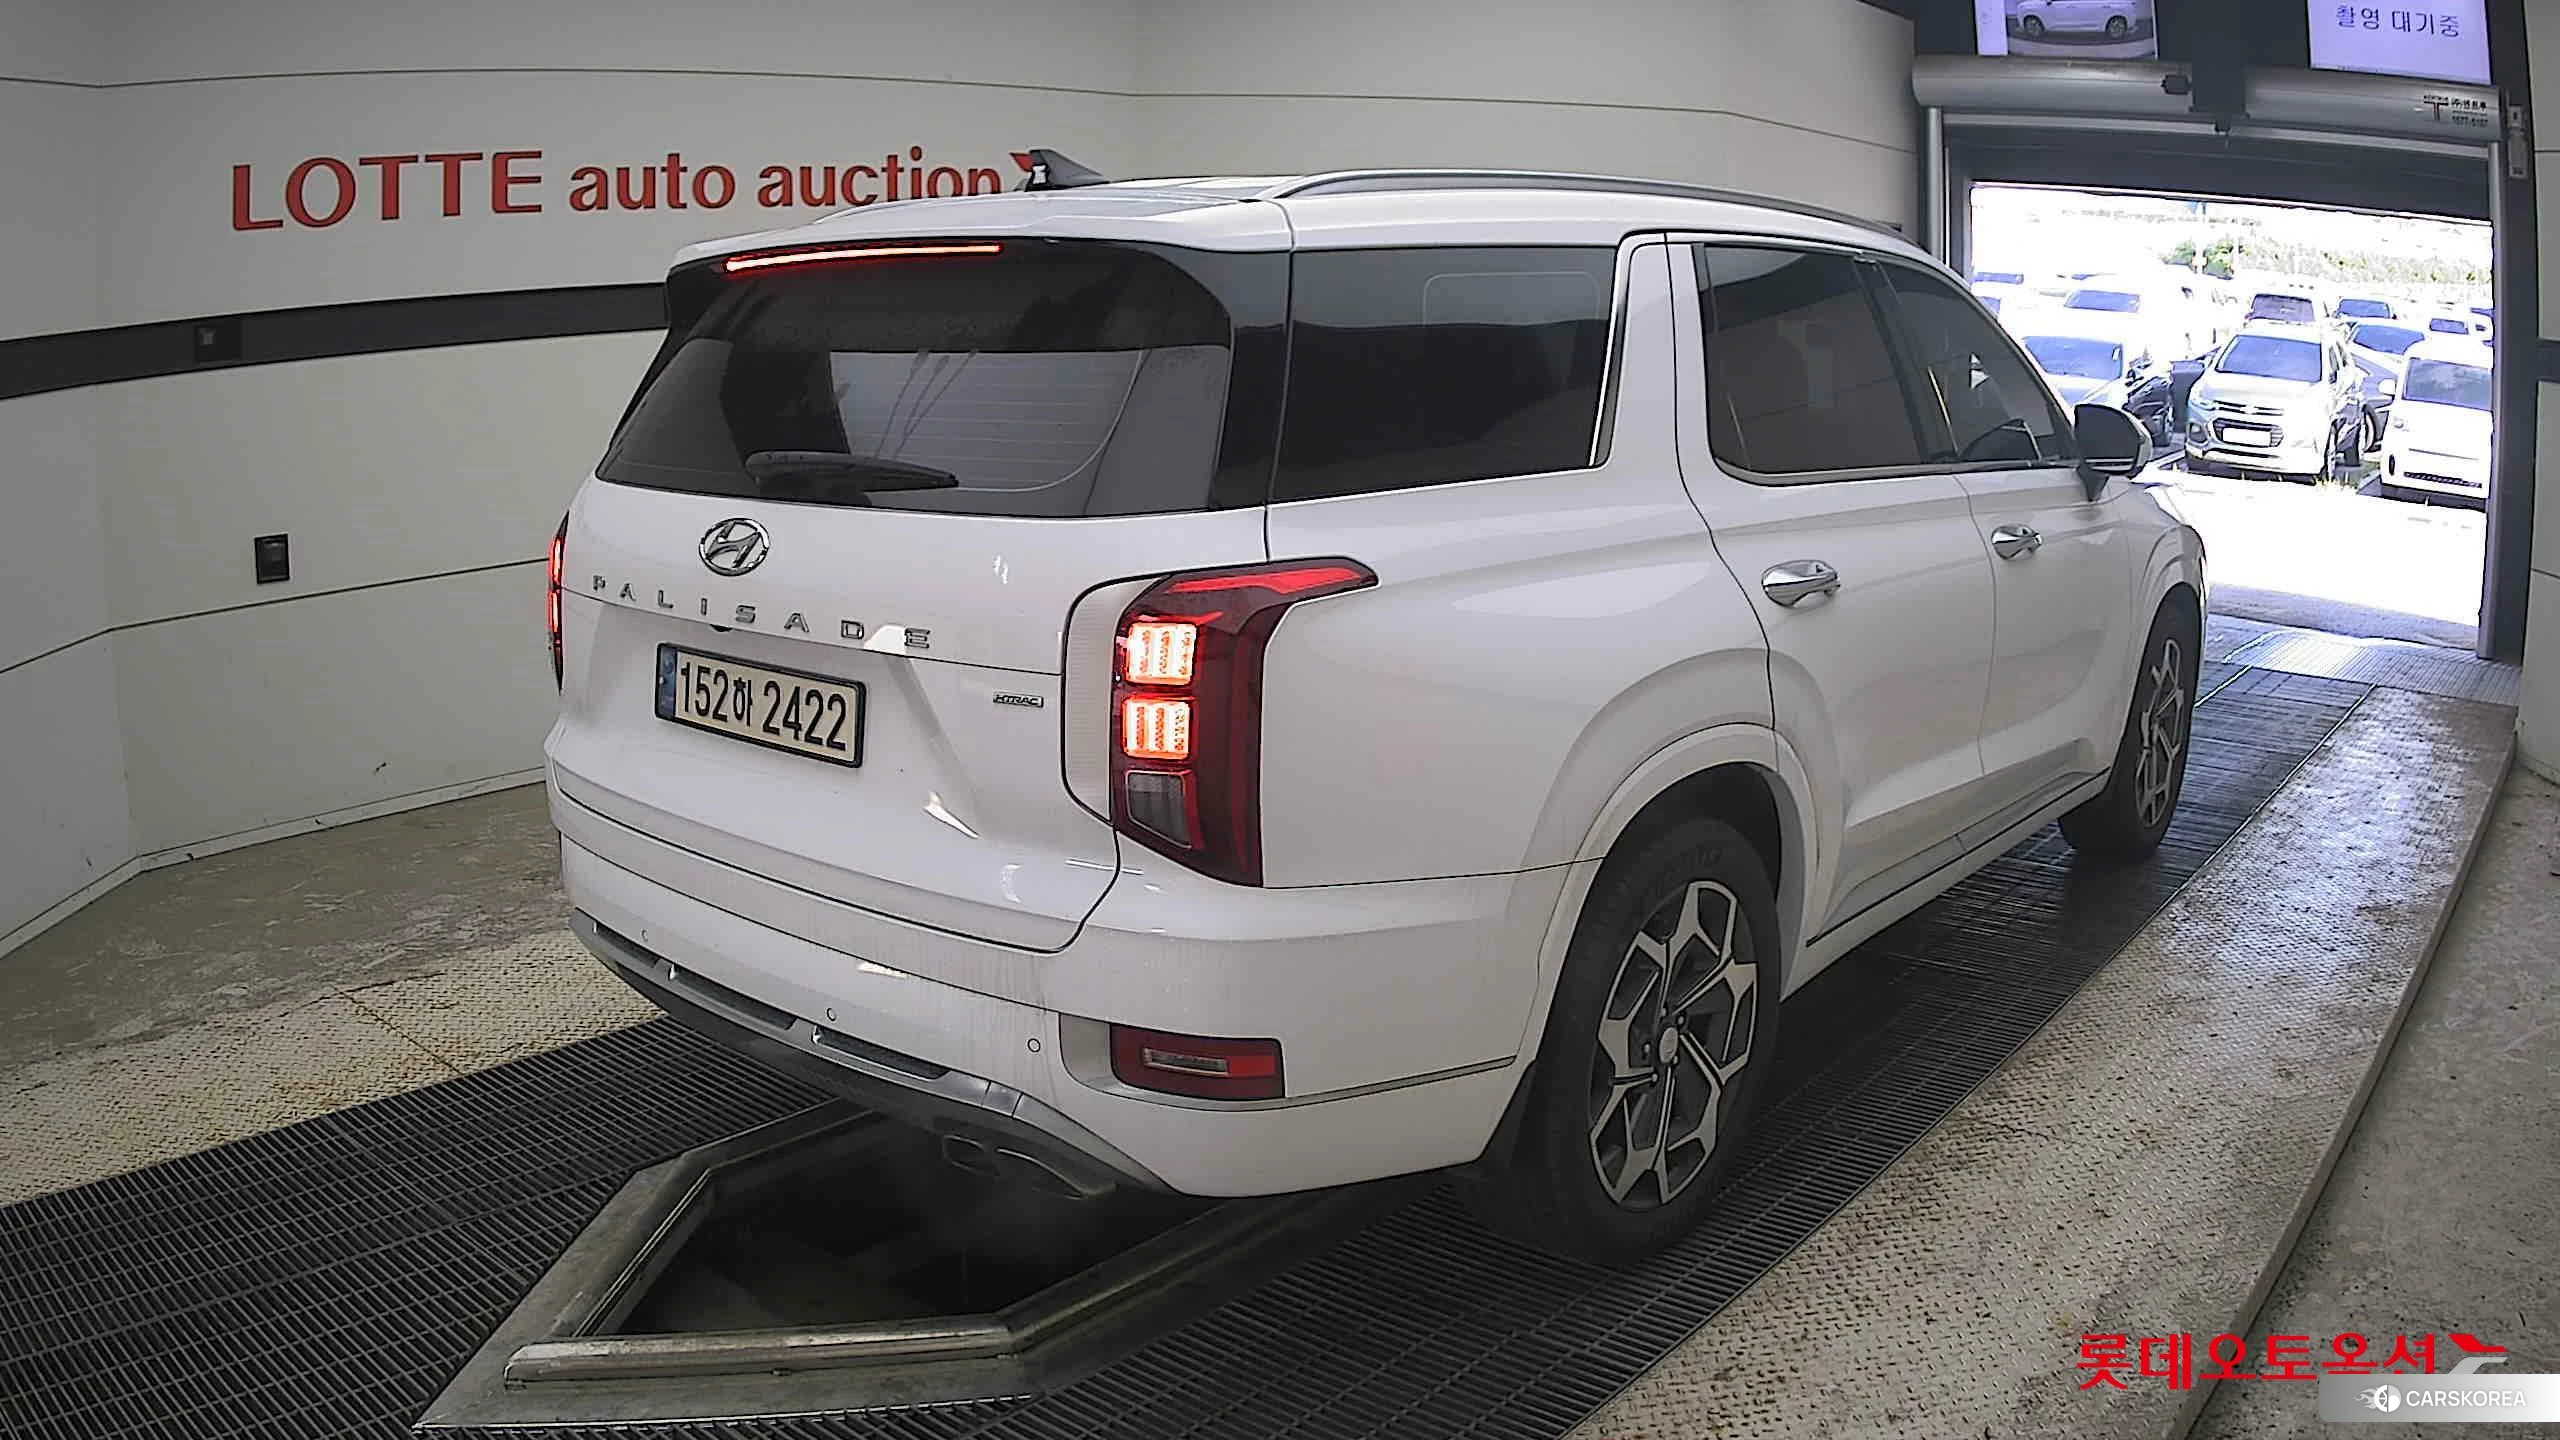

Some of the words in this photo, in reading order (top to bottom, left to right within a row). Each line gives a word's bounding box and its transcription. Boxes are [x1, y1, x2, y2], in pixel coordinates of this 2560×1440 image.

[2391, 11, 2459, 38] 대기중
[233, 150, 543, 231] LOTTE
[569, 152, 736, 212] auto
[757, 145, 1001, 208] auction
[592, 573, 931, 648] PALISADE
